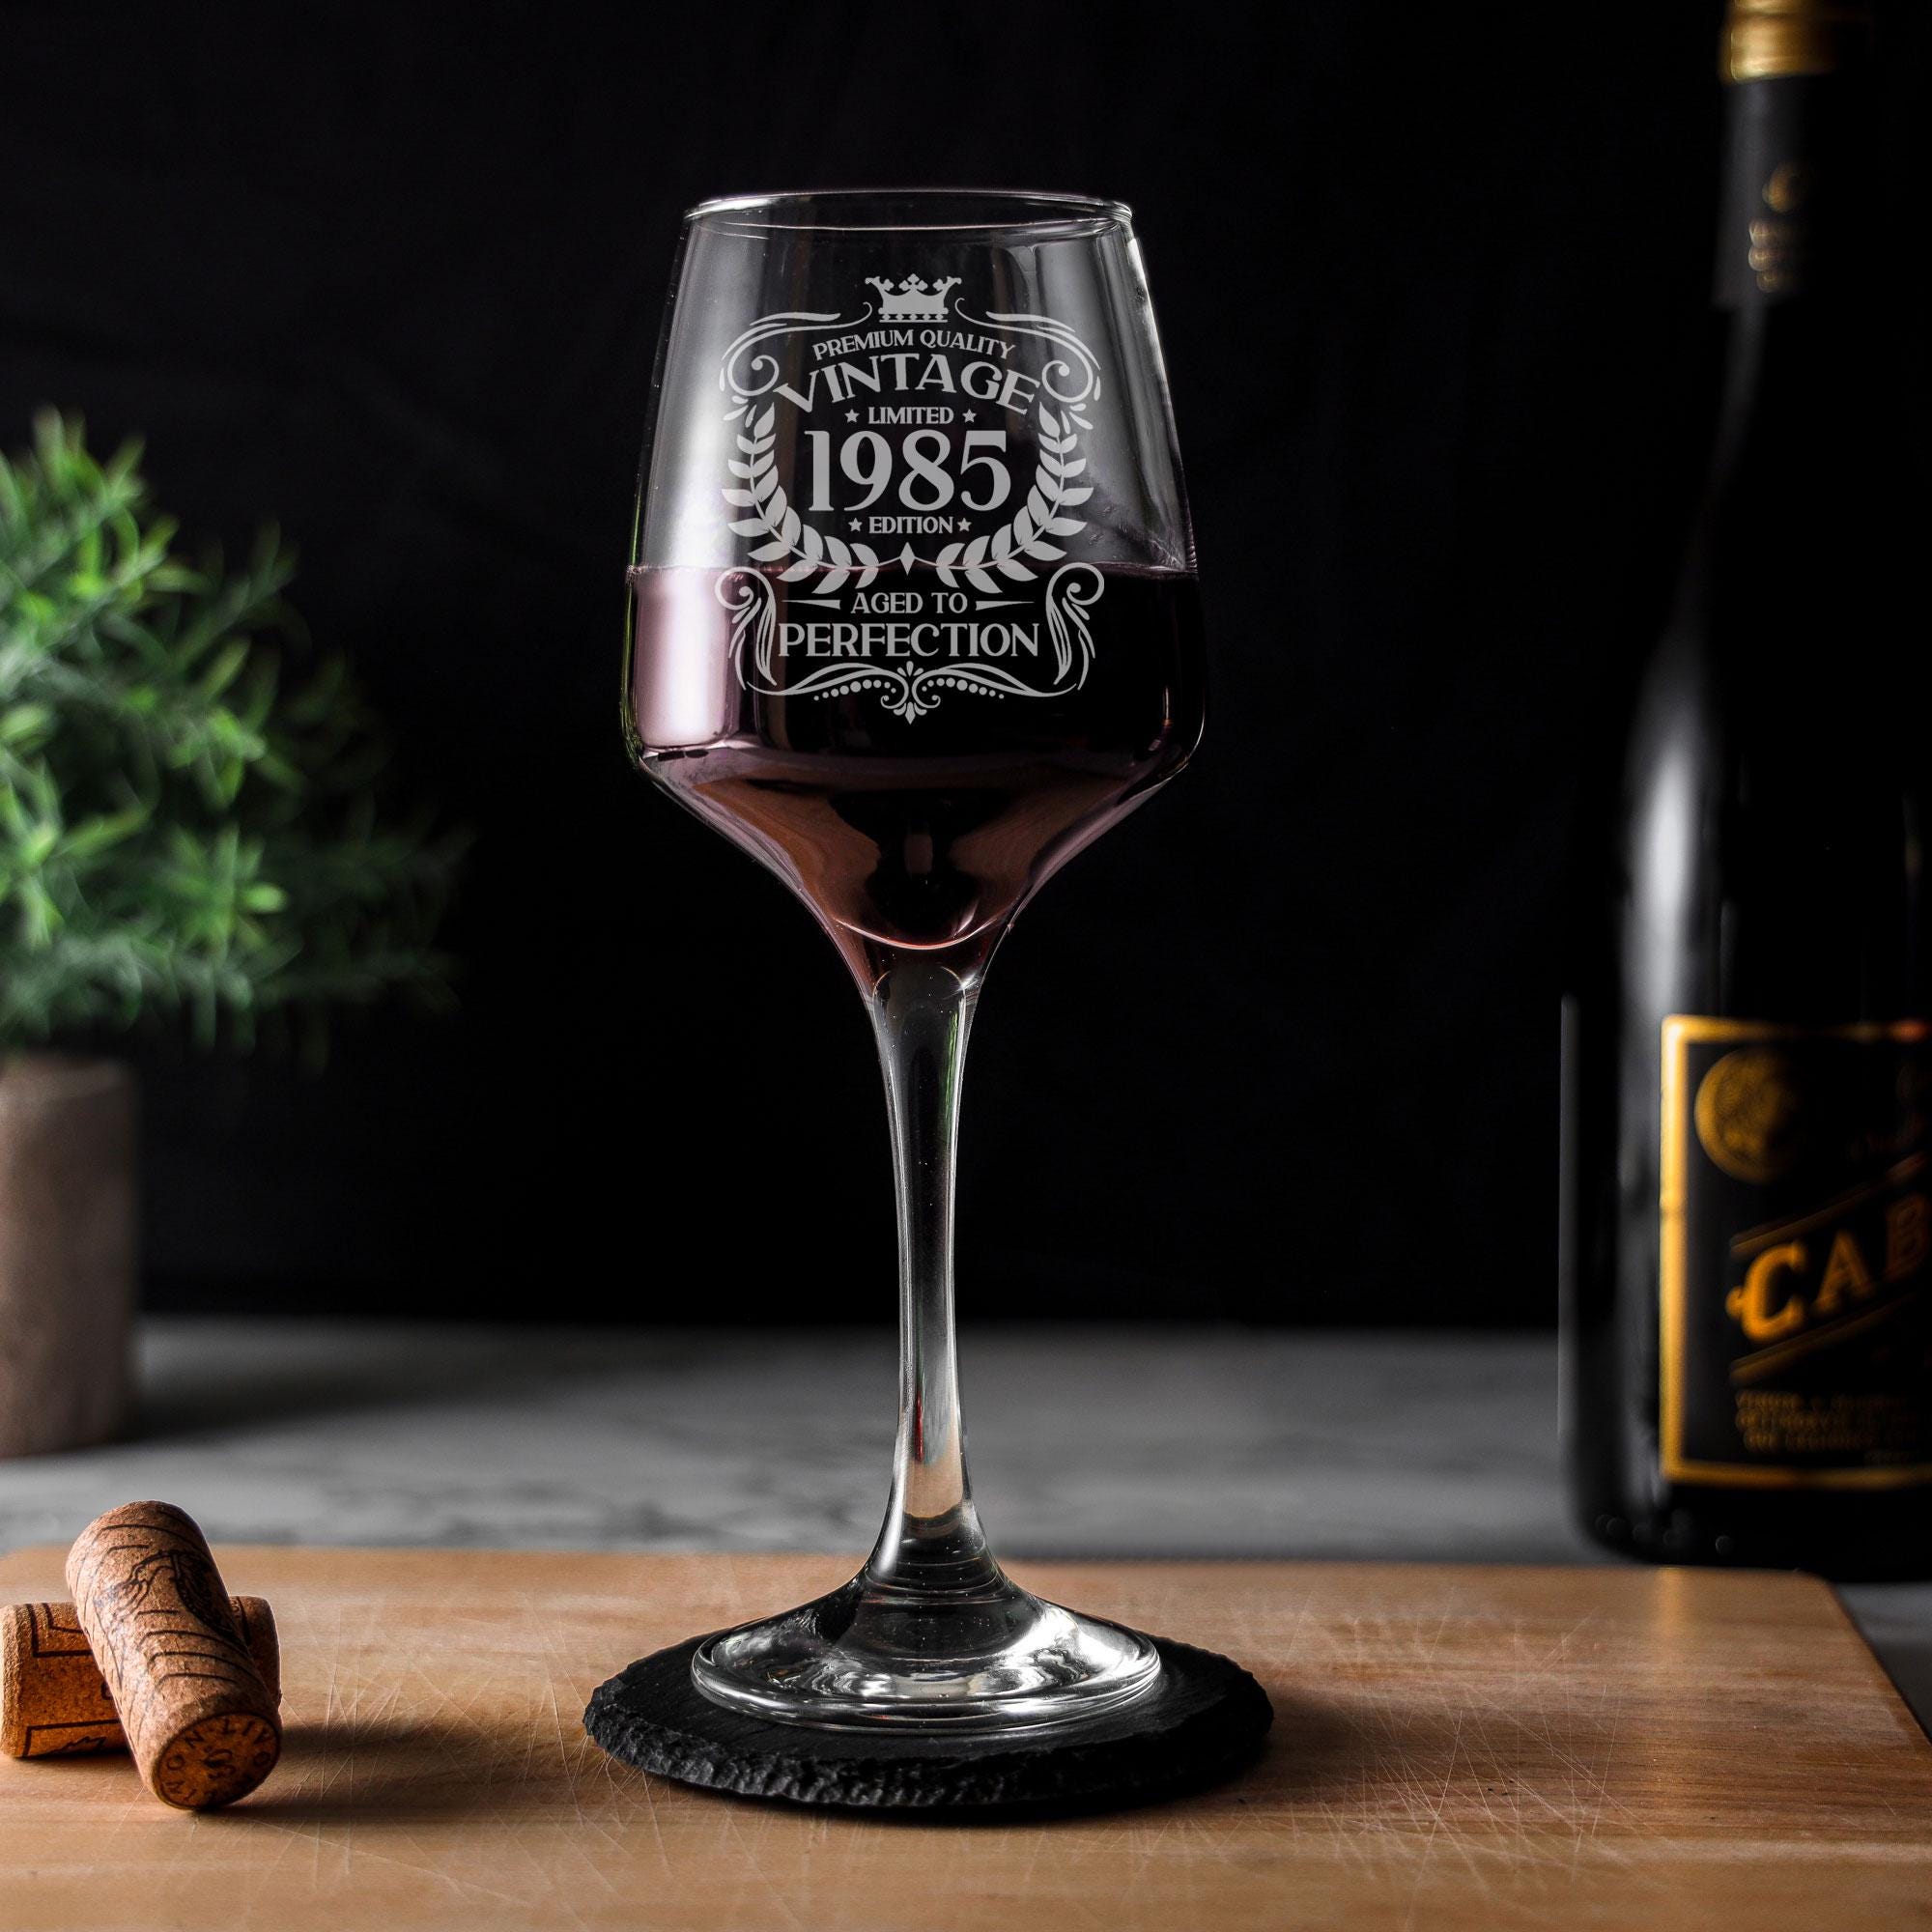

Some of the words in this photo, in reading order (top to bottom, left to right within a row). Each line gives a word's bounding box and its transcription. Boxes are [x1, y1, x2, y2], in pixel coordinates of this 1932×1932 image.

[811, 328, 914, 361] PREMIUM
[920, 328, 1016, 361] QUALITY
[773, 353, 1041, 415] VINTAGE
[868, 406, 954, 425] LIMITED
[804, 429, 1011, 512] 1985
[868, 516, 953, 534] EDITION
[850, 592, 923, 614] AGED
[930, 592, 968, 614] TO
[778, 622, 1039, 657] PERFECTION
